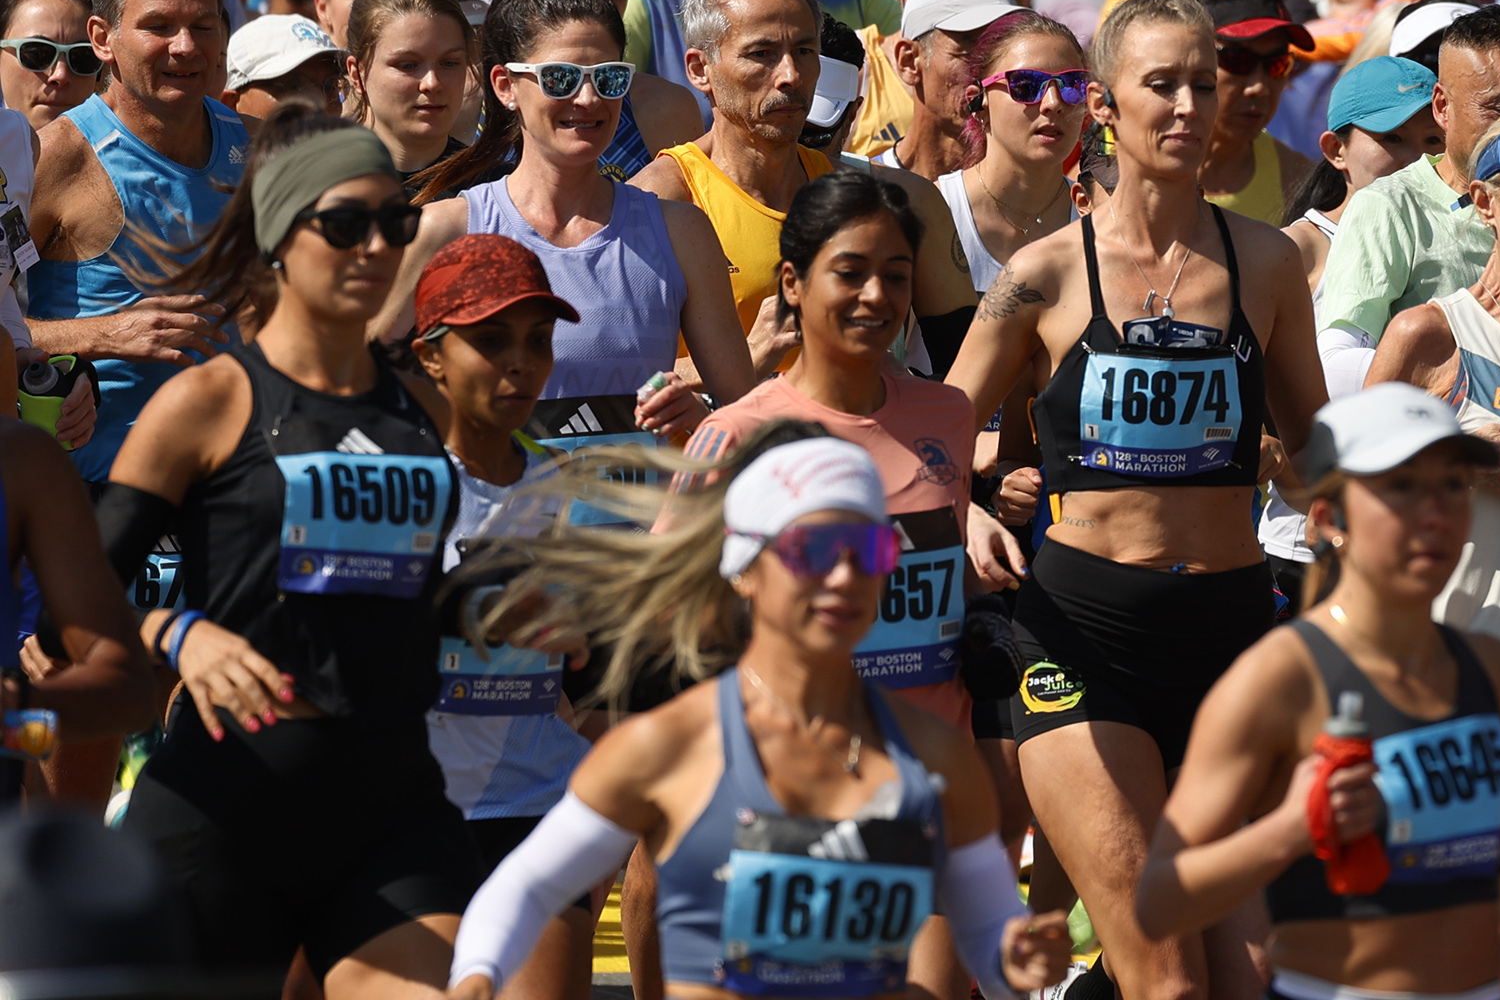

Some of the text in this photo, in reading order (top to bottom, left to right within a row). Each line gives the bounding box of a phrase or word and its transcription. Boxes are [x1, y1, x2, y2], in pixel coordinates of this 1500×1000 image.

[601, 166, 625, 178] OSTON
[1101, 367, 1230, 426] 16874
[1140, 454, 1187, 463] BOSTON
[1115, 462, 1186, 473] MARATHON
[303, 464, 436, 526] 16509
[876, 558, 956, 623] 657
[876, 652, 922, 666] BOSTON
[471, 691, 532, 701] MARATHON
[754, 871, 915, 942] 16130
